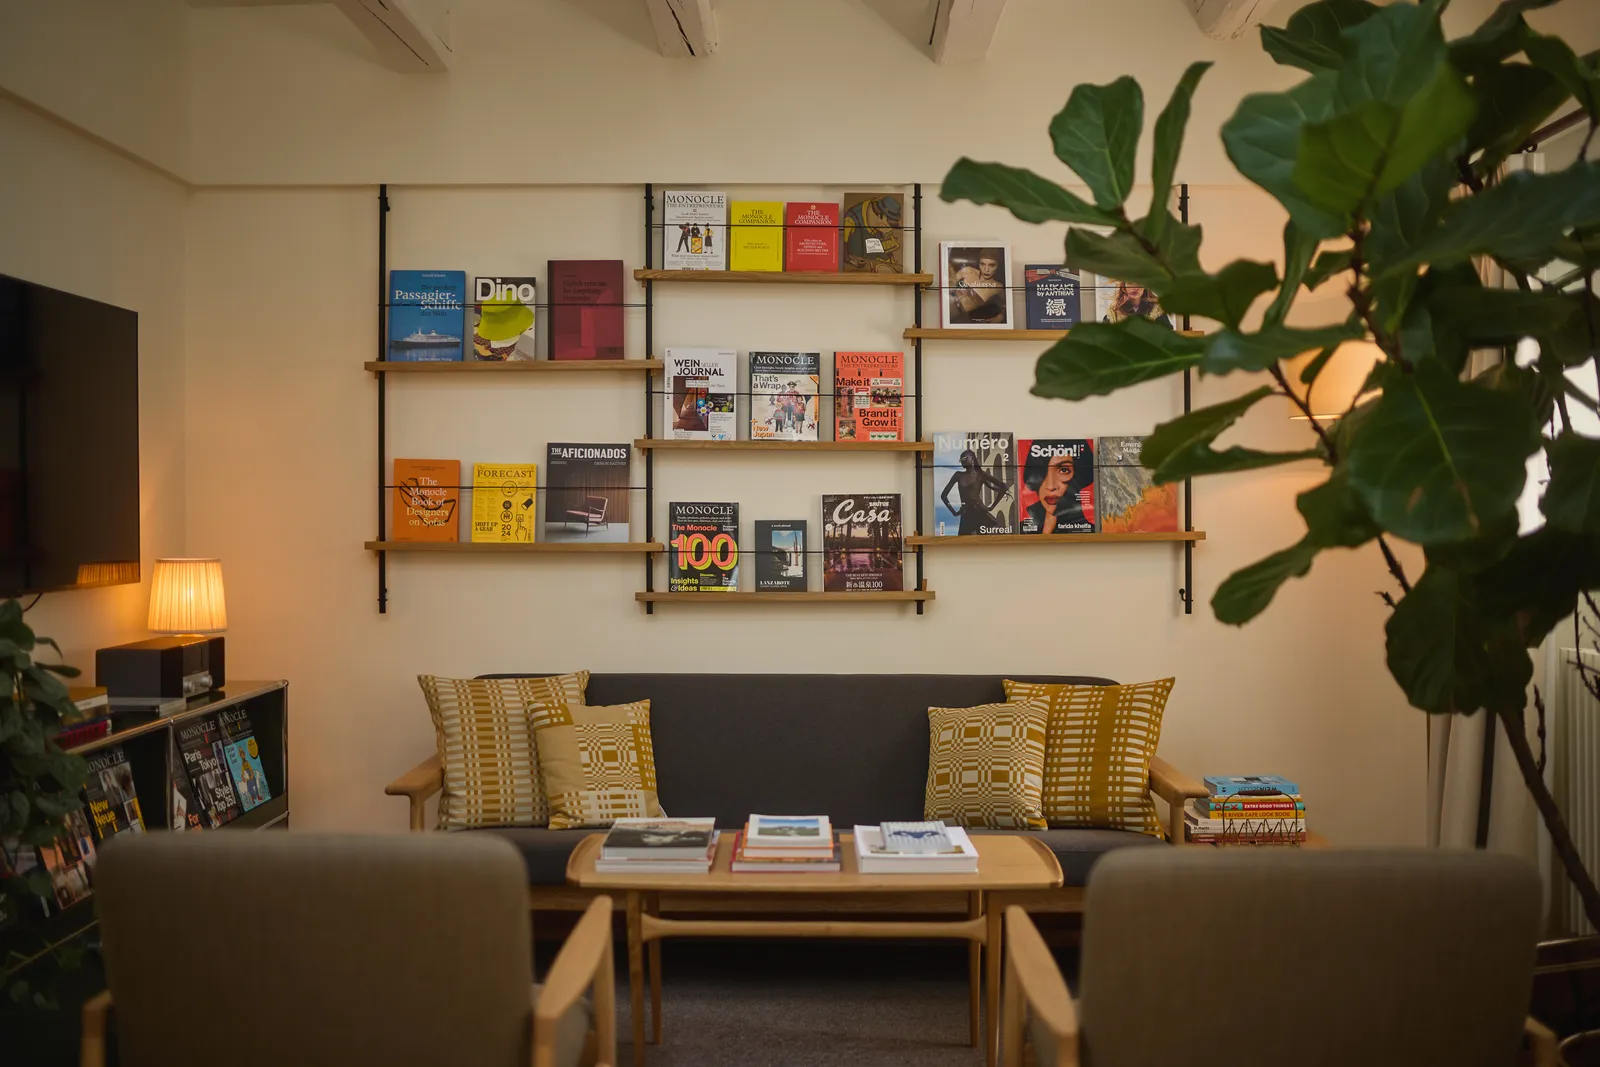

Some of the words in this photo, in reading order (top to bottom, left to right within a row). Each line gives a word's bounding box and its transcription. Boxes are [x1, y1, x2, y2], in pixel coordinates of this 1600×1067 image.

[666, 195, 724, 204] MONOCLE
[476, 278, 535, 301] Dino
[394, 290, 456, 303] Passagier-
[420, 299, 462, 310] Schiffe
[674, 359, 700, 368] WEIN
[757, 356, 814, 365] MONOCLE
[841, 356, 898, 364] MONOCLE
[677, 368, 724, 376] JOURNAL
[760, 382, 781, 390] Wrap
[836, 378, 862, 386] Make
[864, 378, 870, 386] it
[860, 409, 889, 418] Brand
[890, 409, 897, 417] it
[862, 418, 889, 426] Grow
[890, 418, 897, 426] it
[938, 435, 1009, 450] Numéro
[562, 448, 626, 458] AFICIONADOS
[1031, 444, 1077, 457] Schön!
[1003, 454, 1010, 462] 2
[419, 477, 437, 486] The
[410, 487, 447, 496] Monocle
[412, 497, 435, 506] Book
[406, 507, 449, 517] Designers
[676, 506, 734, 515] MONOCLE
[833, 499, 892, 525] Casa
[423, 518, 446, 526] Sofas
[980, 526, 1012, 534] Surreal
[670, 533, 738, 570] 100
[180, 720, 216, 740] MONOCLE
[184, 750, 202, 764] Paris
[199, 757, 217, 771] Tokyo
[90, 800, 108, 814] New
[214, 800, 226, 812] Top
[94, 810, 116, 826] Neue
